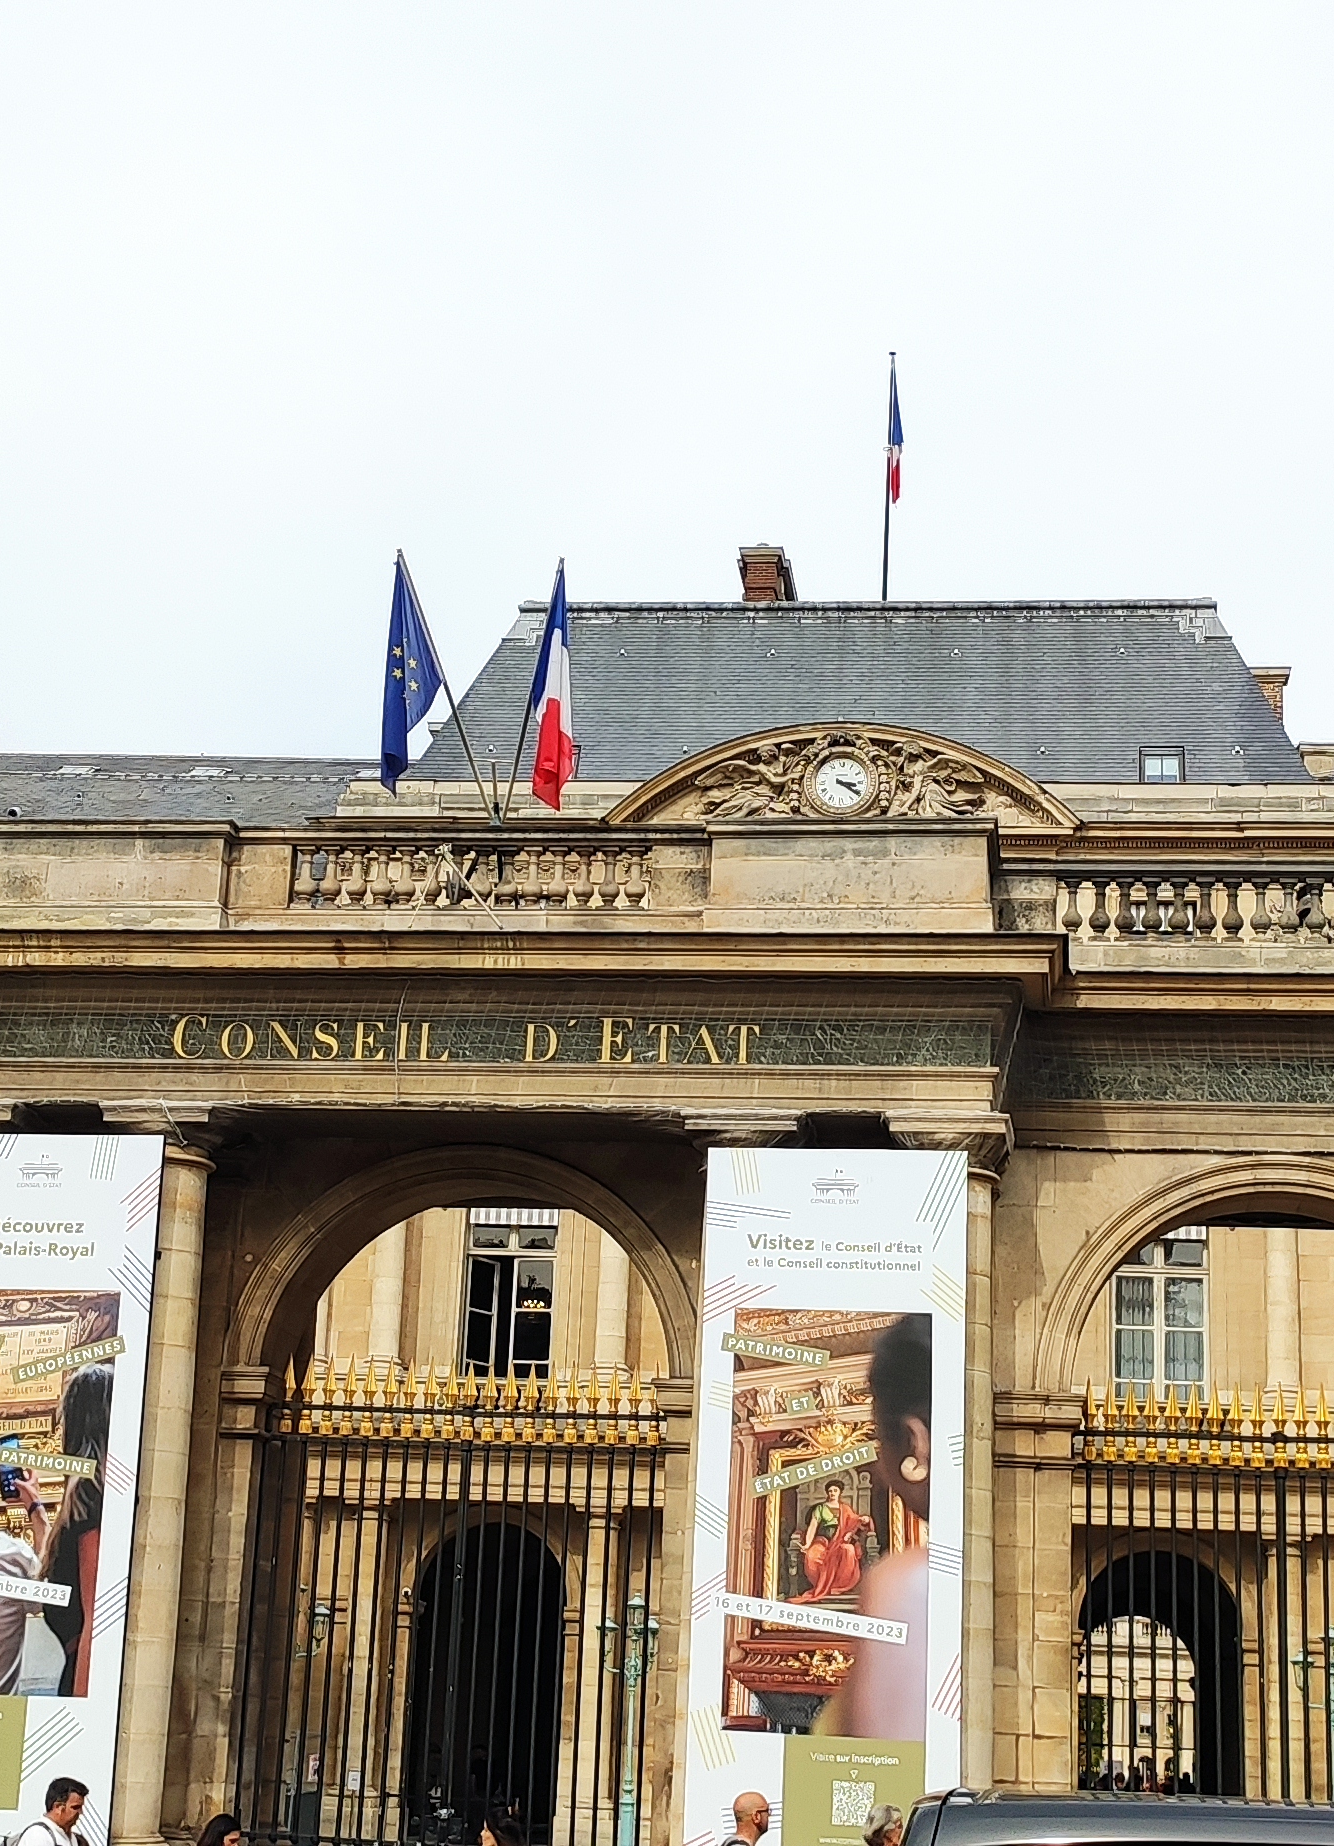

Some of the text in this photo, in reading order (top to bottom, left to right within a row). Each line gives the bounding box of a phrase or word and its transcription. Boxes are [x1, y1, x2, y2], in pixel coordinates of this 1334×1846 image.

[173, 1014, 449, 1061] CONSEIL
[747, 1234, 922, 1254] Visitez le Conseil d'État
[747, 1256, 921, 1272] et le Conseil constitutionnel
[18, 1341, 121, 1380] EUROPÉENNES
[727, 1337, 823, 1365] PATRIMOINE
[791, 1397, 809, 1412] ET
[1, 1451, 91, 1474] PATRIMOINE
[754, 1446, 869, 1493] ÉTAT DE DROIT
[33, 1586, 66, 1600] 2023
[714, 1596, 903, 1639] 16 et 17 septembre 2023
